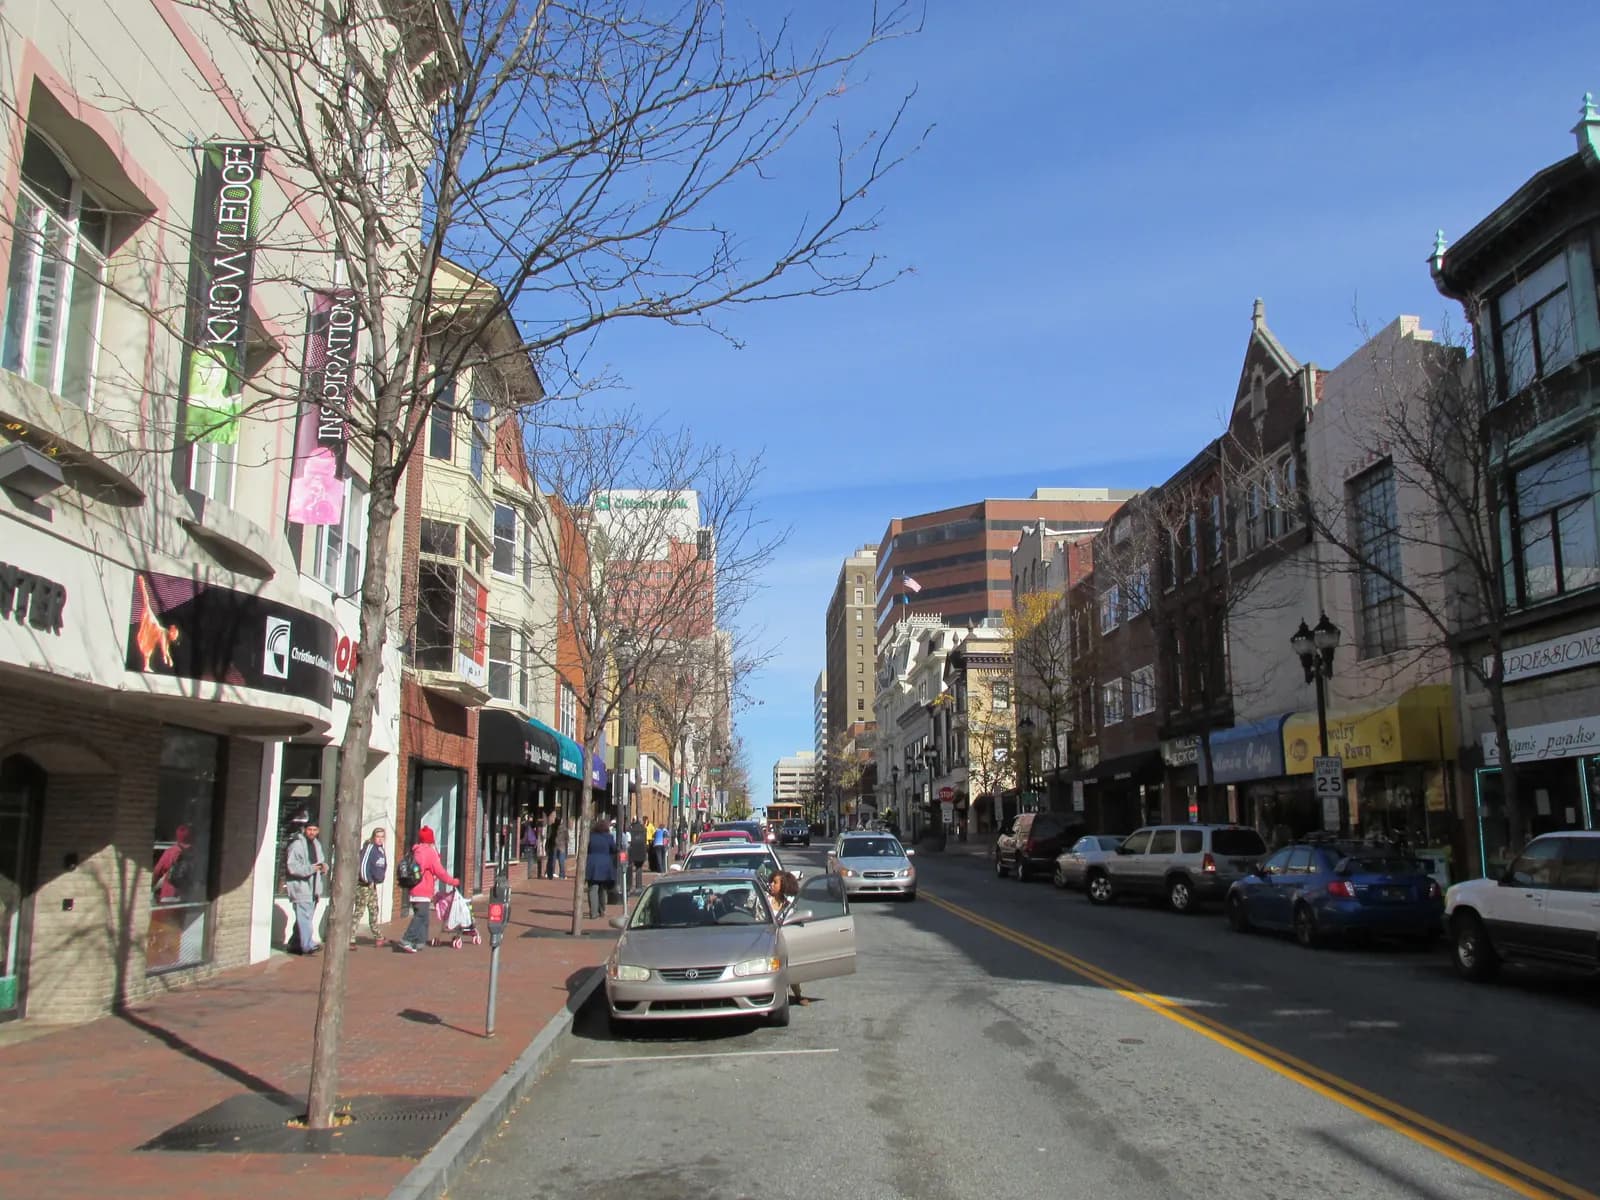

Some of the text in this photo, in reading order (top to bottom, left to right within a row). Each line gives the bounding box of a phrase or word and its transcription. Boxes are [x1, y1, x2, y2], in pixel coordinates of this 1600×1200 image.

[206, 147, 256, 347] KNOWLEDGE
[1344, 743, 1372, 760] Pawn
[1315, 759, 1340, 768] SPEED
[1318, 767, 1338, 776] LIMIT
[1317, 776, 1342, 793] 25
[939, 791, 954, 799] STOP
